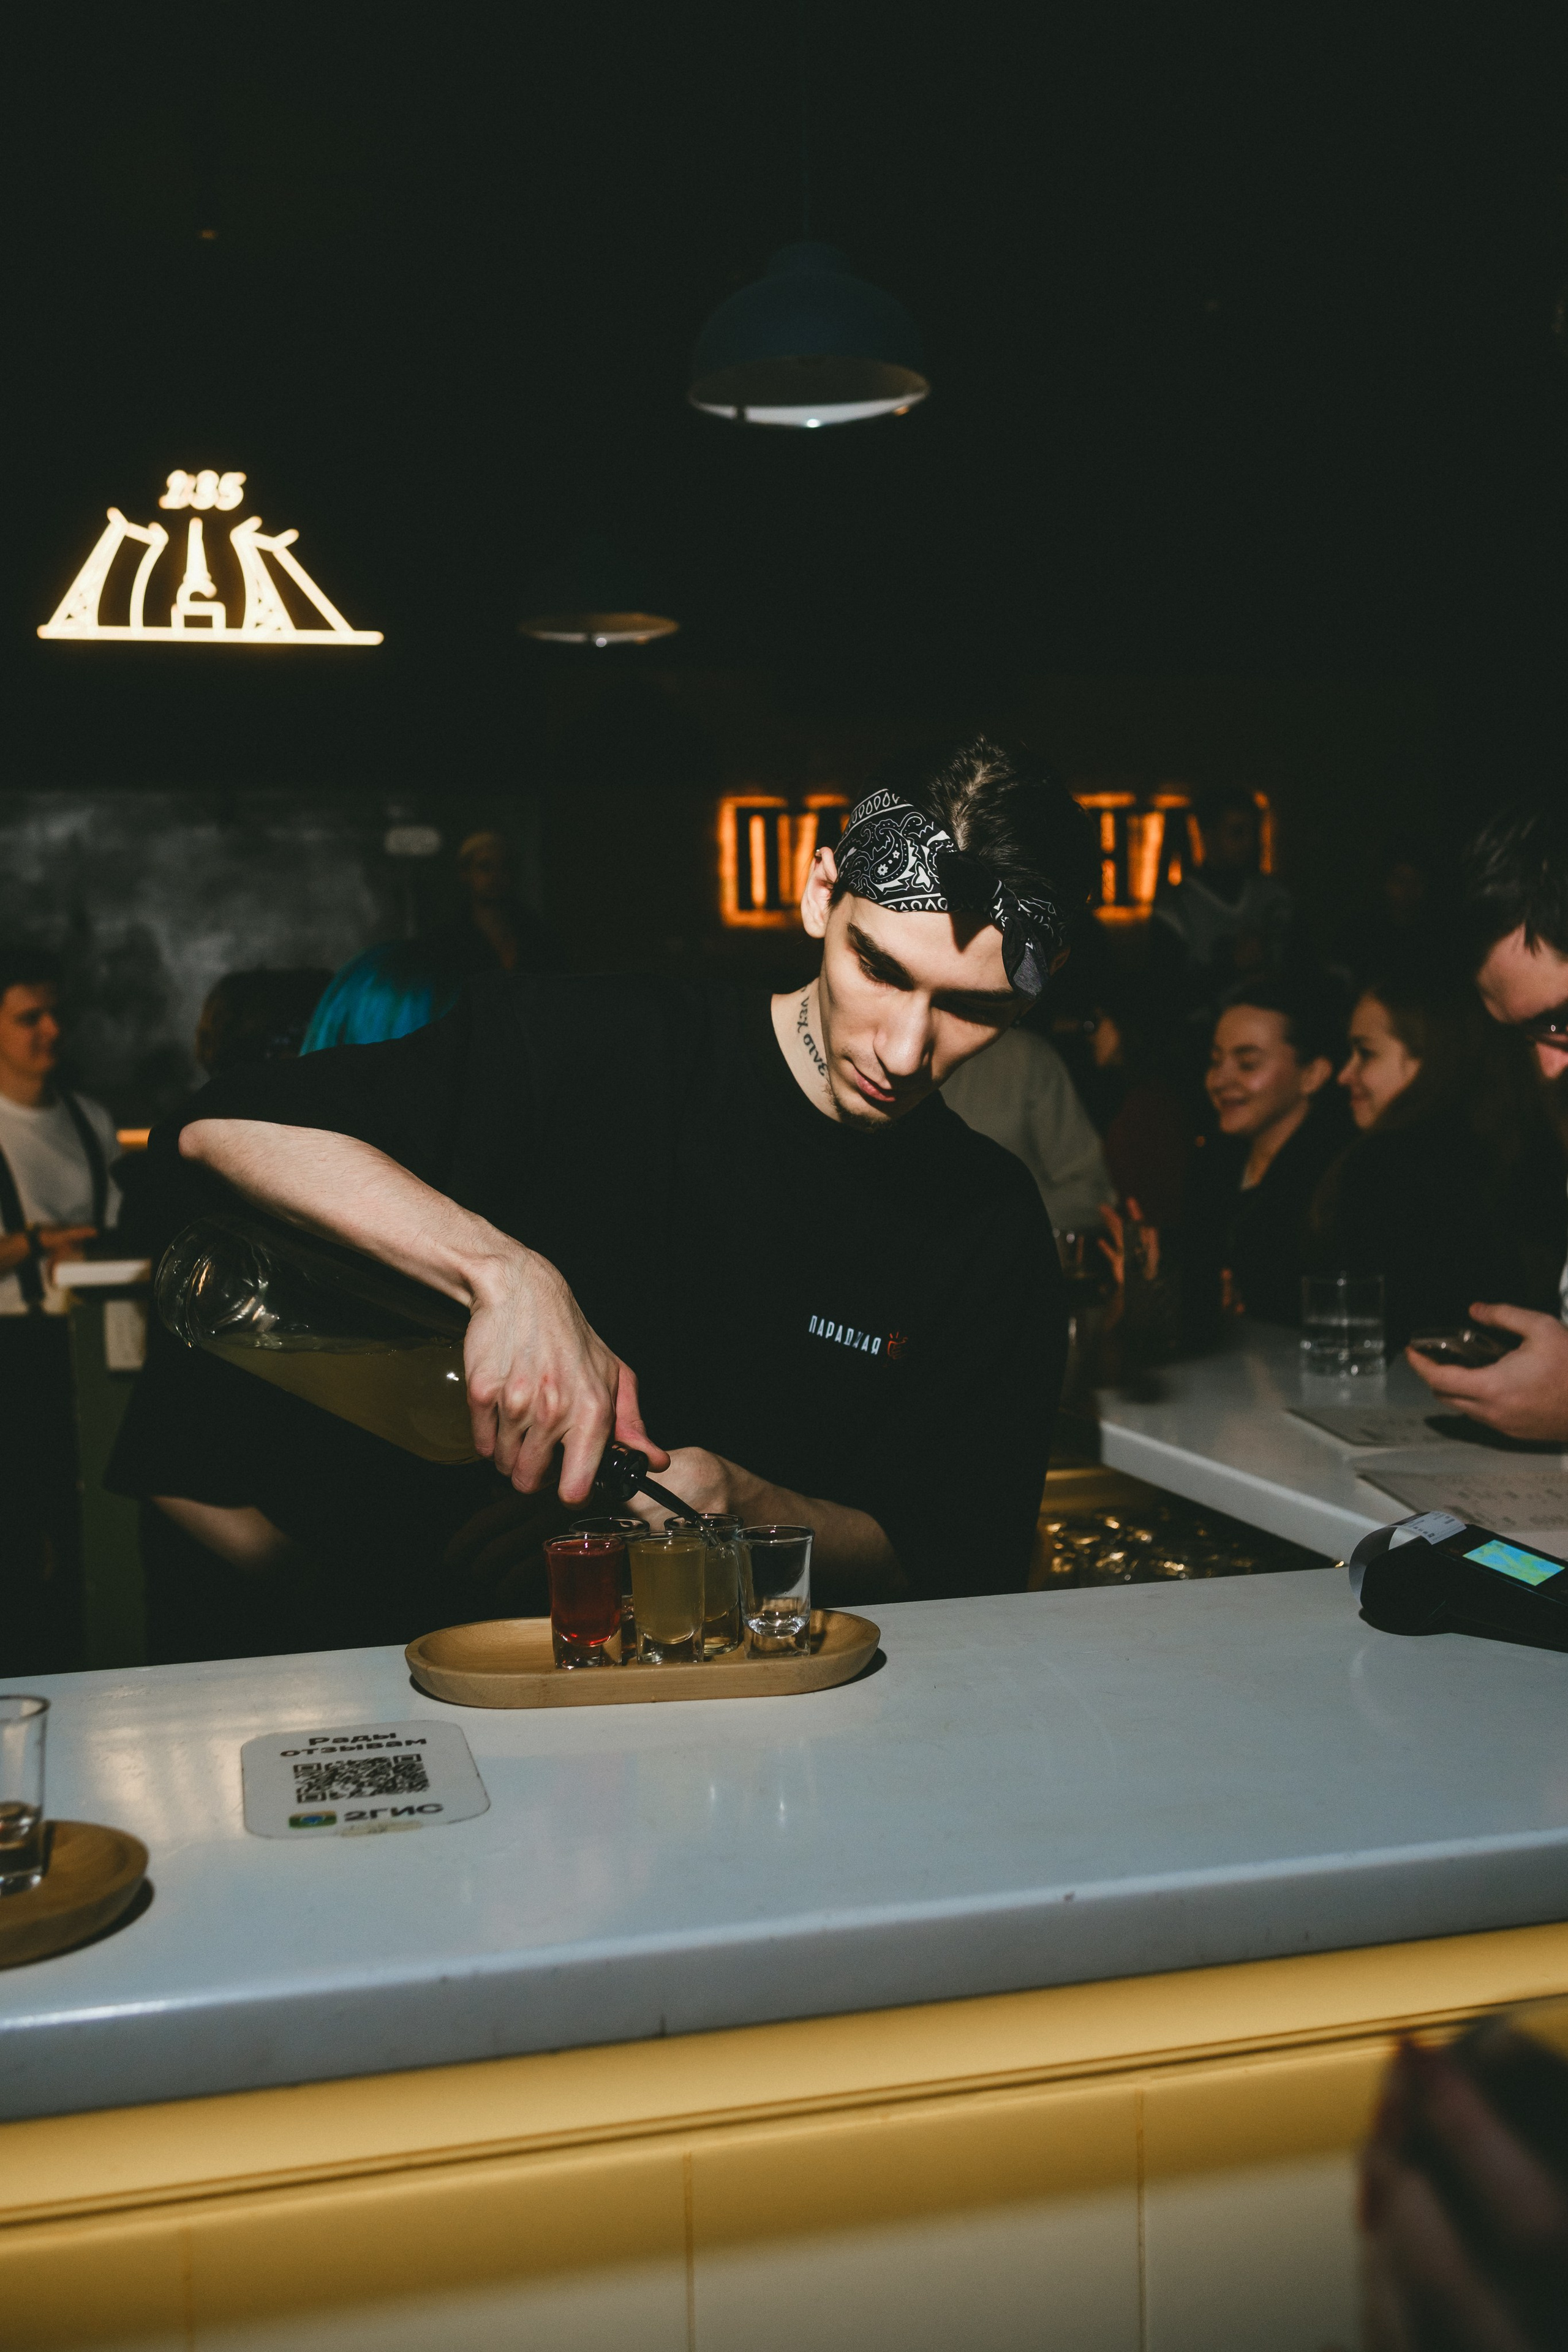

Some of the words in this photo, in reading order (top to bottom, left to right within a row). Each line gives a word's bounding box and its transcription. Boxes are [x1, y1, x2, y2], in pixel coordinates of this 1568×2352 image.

[280, 1738, 427, 1757] отзывам
[309, 1733, 396, 1746] Рады
[344, 1803, 443, 1822] 2ГИС
